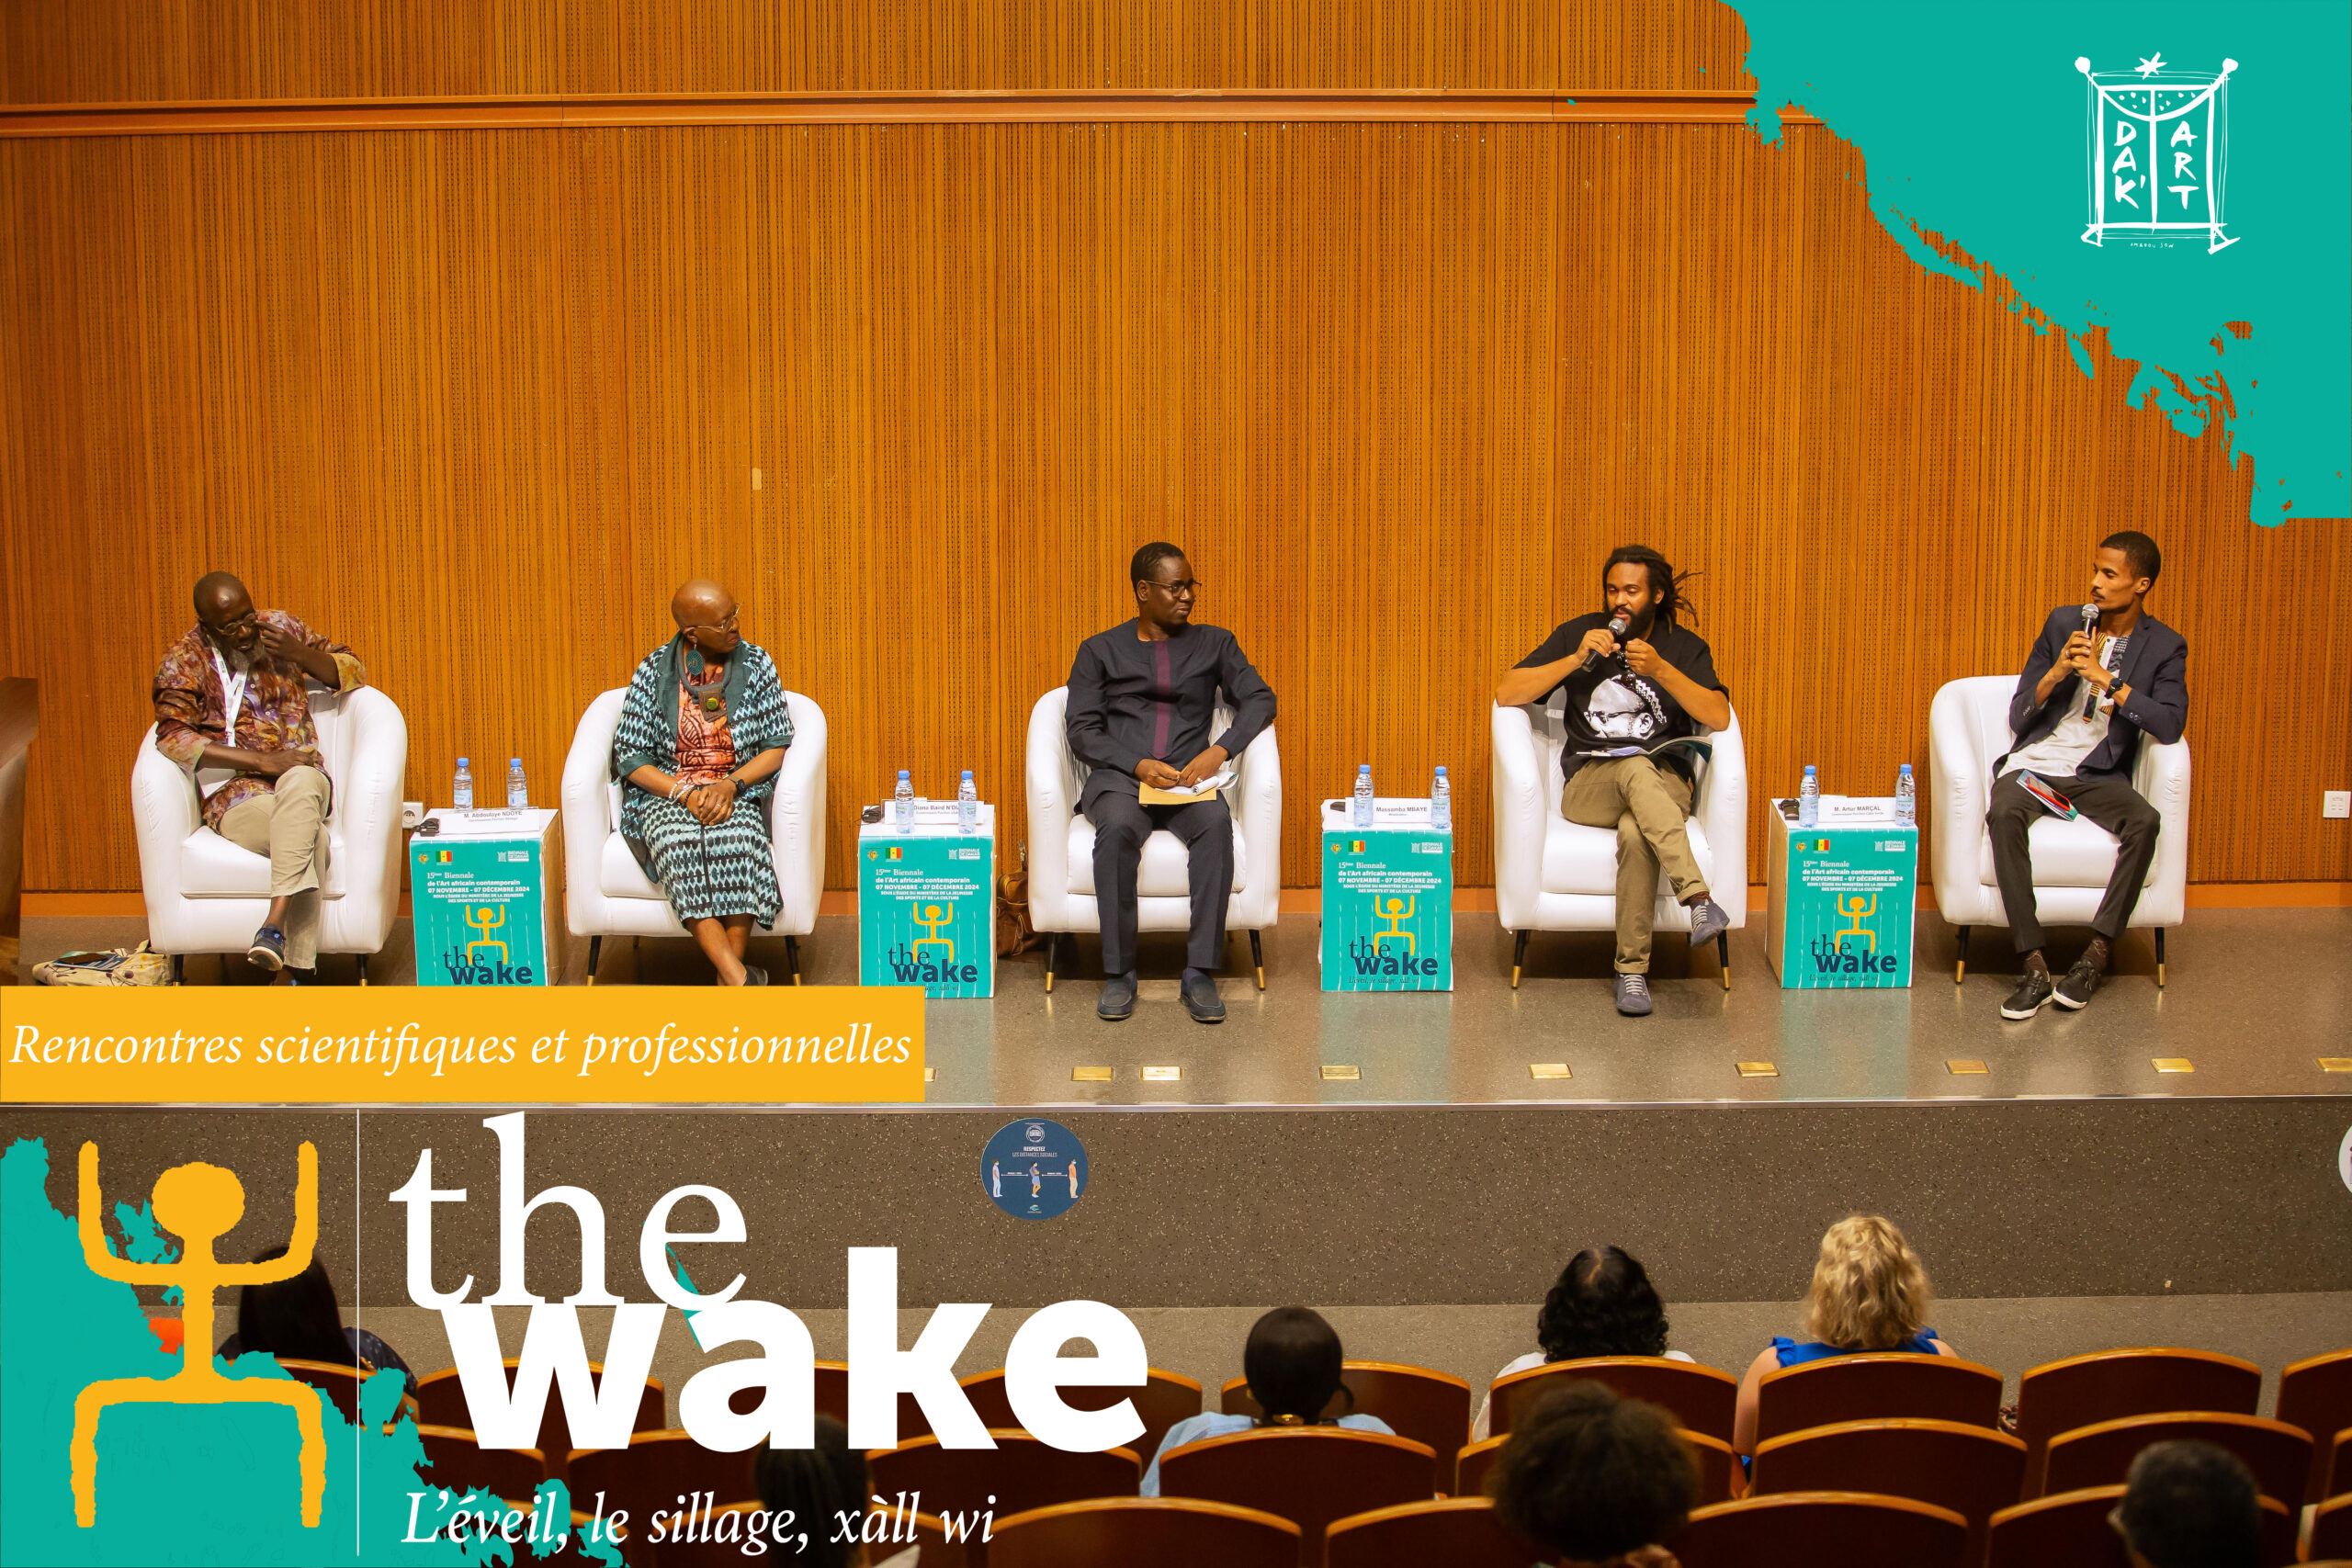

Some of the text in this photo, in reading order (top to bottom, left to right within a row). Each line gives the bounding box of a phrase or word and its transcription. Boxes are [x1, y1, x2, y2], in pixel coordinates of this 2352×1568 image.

[888, 943, 930, 966] the
[1349, 936, 1391, 959] the
[1810, 934, 1851, 957] the
[442, 946, 485, 969] the
[1355, 952, 1438, 976] wake
[1816, 950, 1897, 973] wake
[450, 961, 533, 985] wake
[893, 959, 978, 983] wake
